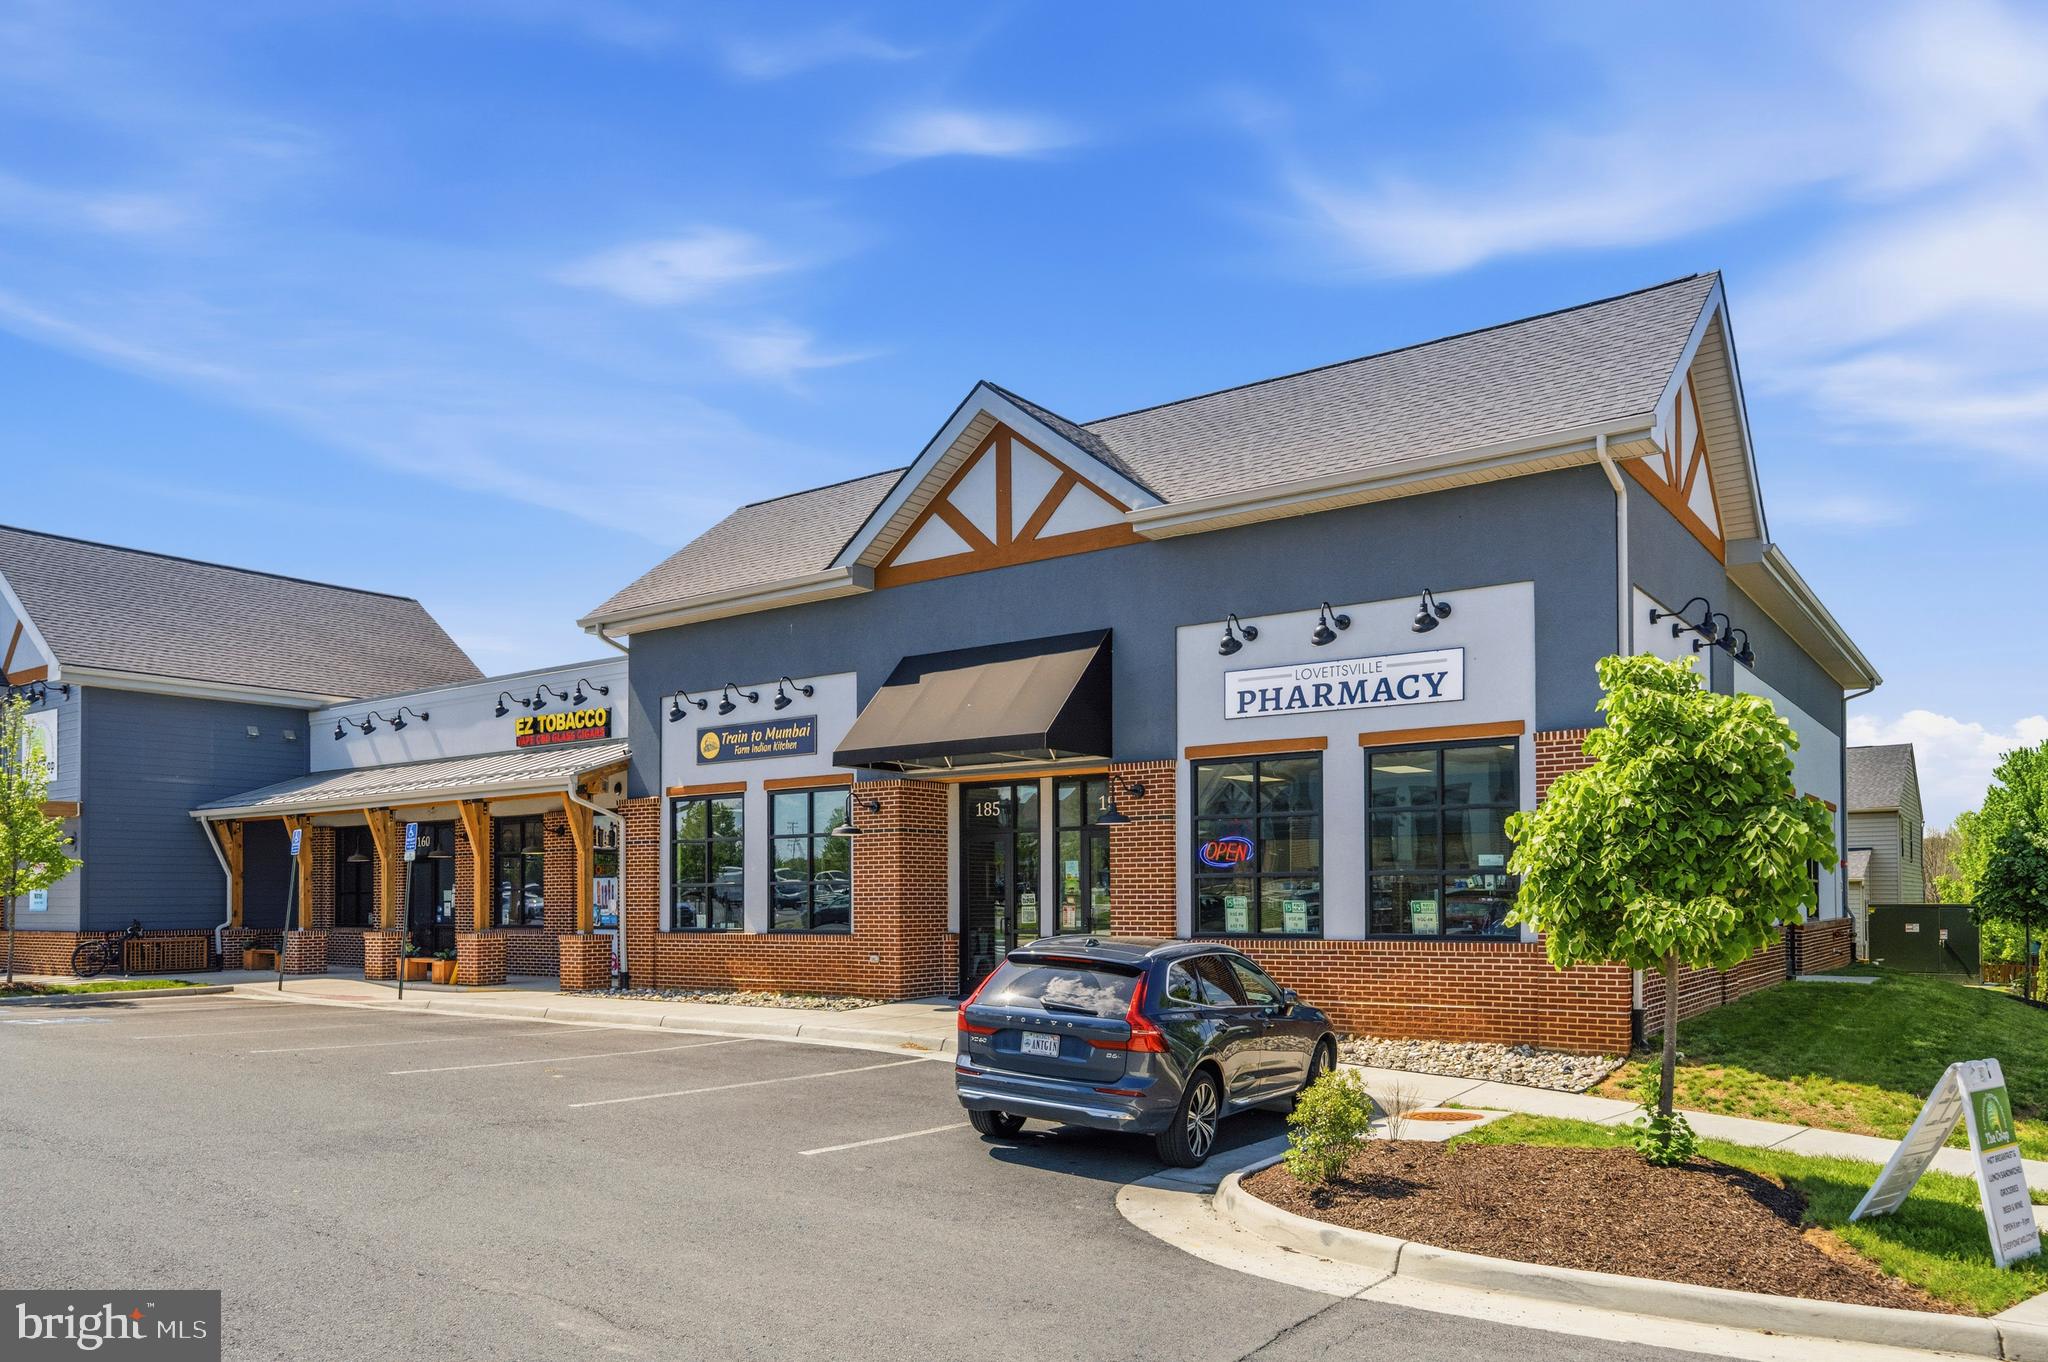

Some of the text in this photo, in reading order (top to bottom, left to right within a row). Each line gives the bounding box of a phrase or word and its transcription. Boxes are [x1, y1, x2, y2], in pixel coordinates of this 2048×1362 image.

[1295, 661, 1383, 681] LOVETTSVILLE
[1237, 671, 1449, 714] PHARMACY
[515, 707, 607, 736] EZ TOBACCO
[721, 722, 811, 745] Train to Mumbai
[752, 743, 772, 753] Indian
[773, 740, 798, 751] Kitchen
[976, 801, 1000, 816] 185
[417, 836, 430, 847] 160
[1206, 841, 1248, 862] OPEN
